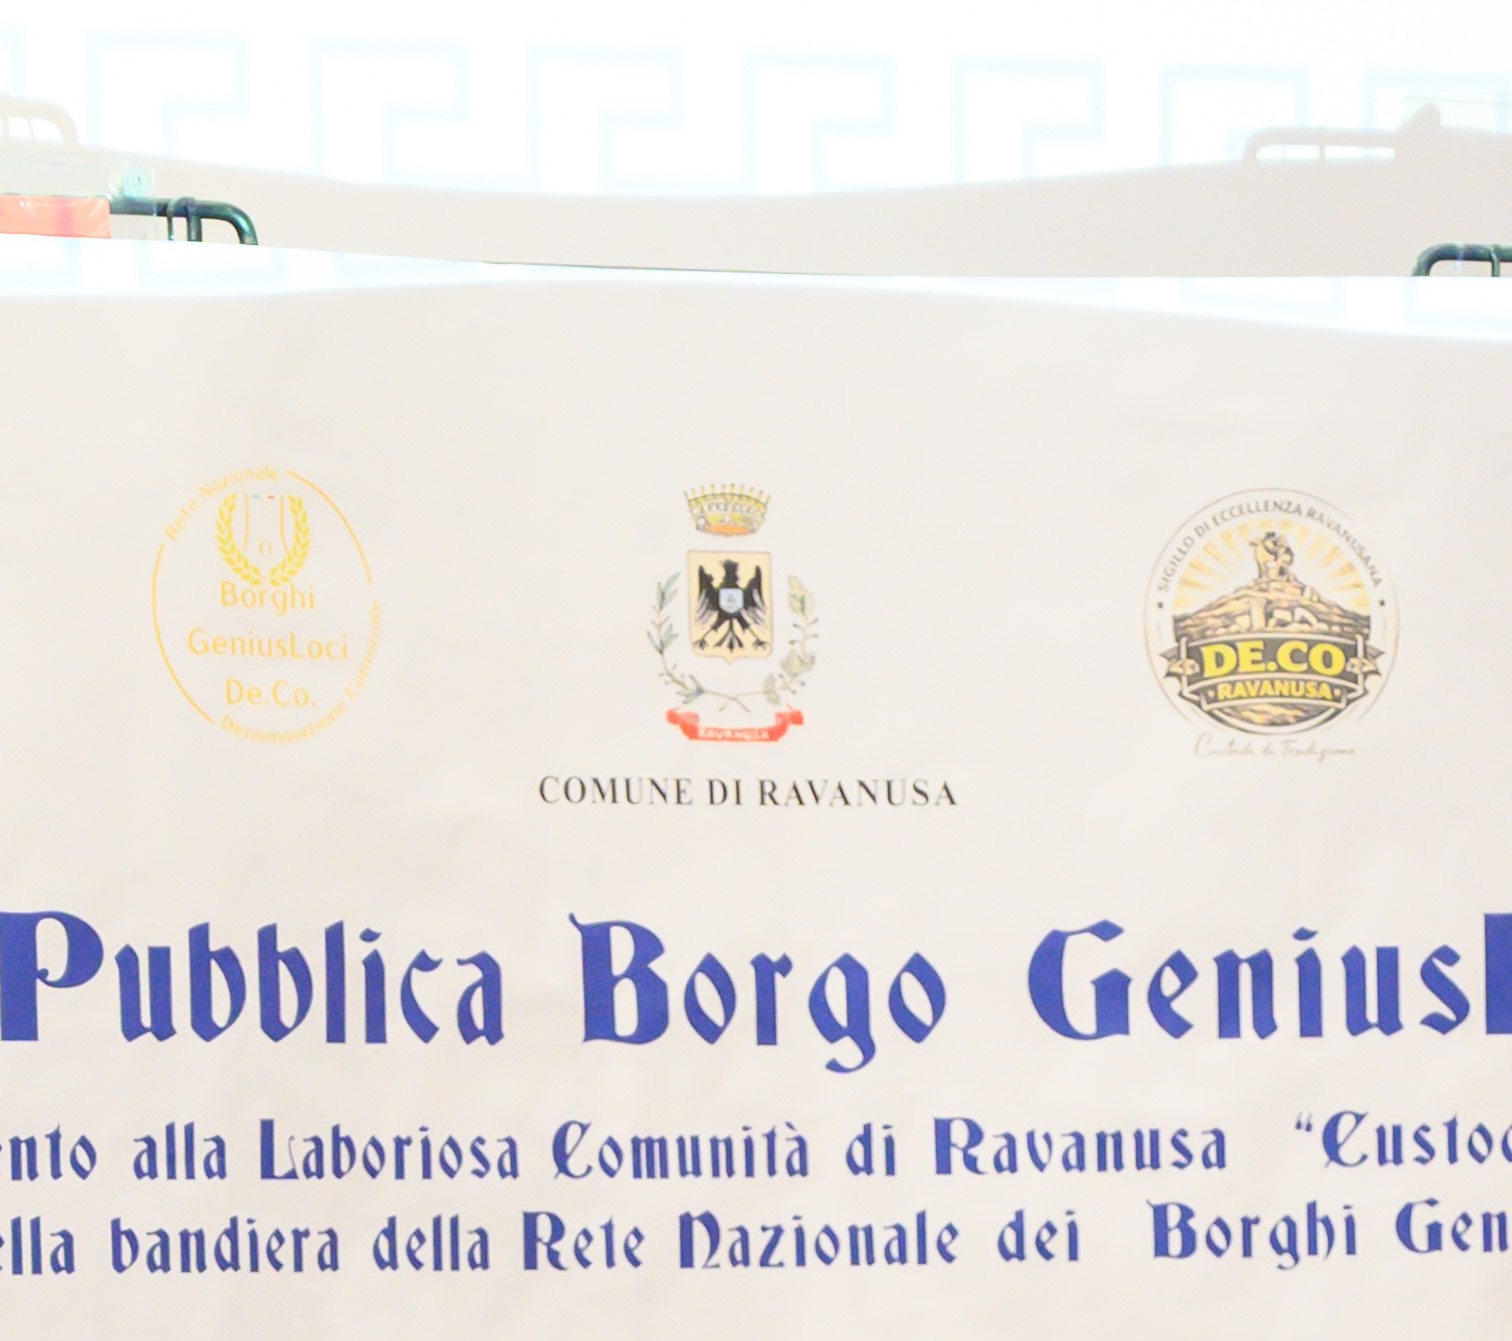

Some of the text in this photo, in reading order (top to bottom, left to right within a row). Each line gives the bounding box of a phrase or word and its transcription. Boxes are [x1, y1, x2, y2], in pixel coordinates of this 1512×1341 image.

[164, 465, 279, 541] Rete Nazionale
[1158, 499, 1383, 593] SIGILLO DI ECCELLENZA RAVANUSANA
[220, 580, 315, 616] Borghi
[187, 627, 348, 659] GeniusLoci
[1200, 639, 1347, 678] DE.CO
[224, 677, 317, 708] De.Co.
[1217, 680, 1332, 701] RAVANUSA
[538, 775, 959, 808] COMUNE DI RAVANUSA
[567, 912, 948, 1075] Borgo
[131, 1120, 227, 1183] alla
[257, 1118, 521, 1181] Laboriosa
[551, 1119, 812, 1181] Comunità
[844, 1122, 899, 1178] di
[932, 1116, 1228, 1175] Ravanusa
[108, 1215, 341, 1274] bandiera
[371, 1213, 492, 1273] della
[520, 1209, 647, 1272] Rete
[677, 1208, 961, 1272] Nazionale
[994, 1207, 1084, 1266] dei
[1149, 1197, 1360, 1272] Borghi
